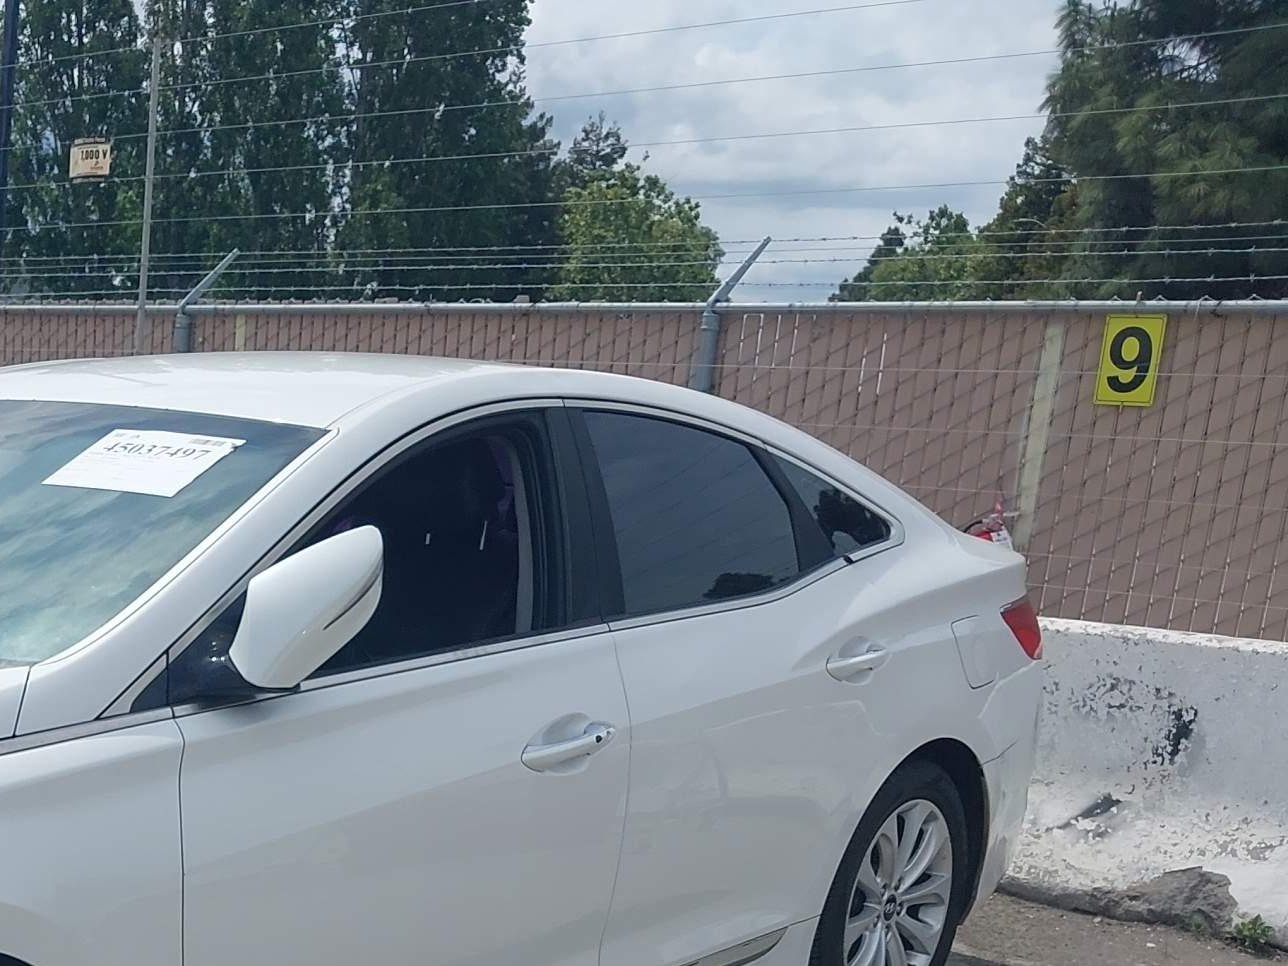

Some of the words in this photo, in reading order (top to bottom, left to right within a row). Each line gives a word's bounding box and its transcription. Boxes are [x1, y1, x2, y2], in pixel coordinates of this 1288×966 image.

[102, 149, 108, 160] V
[1107, 326, 1153, 393] 9
[103, 441, 212, 460] 45037497
